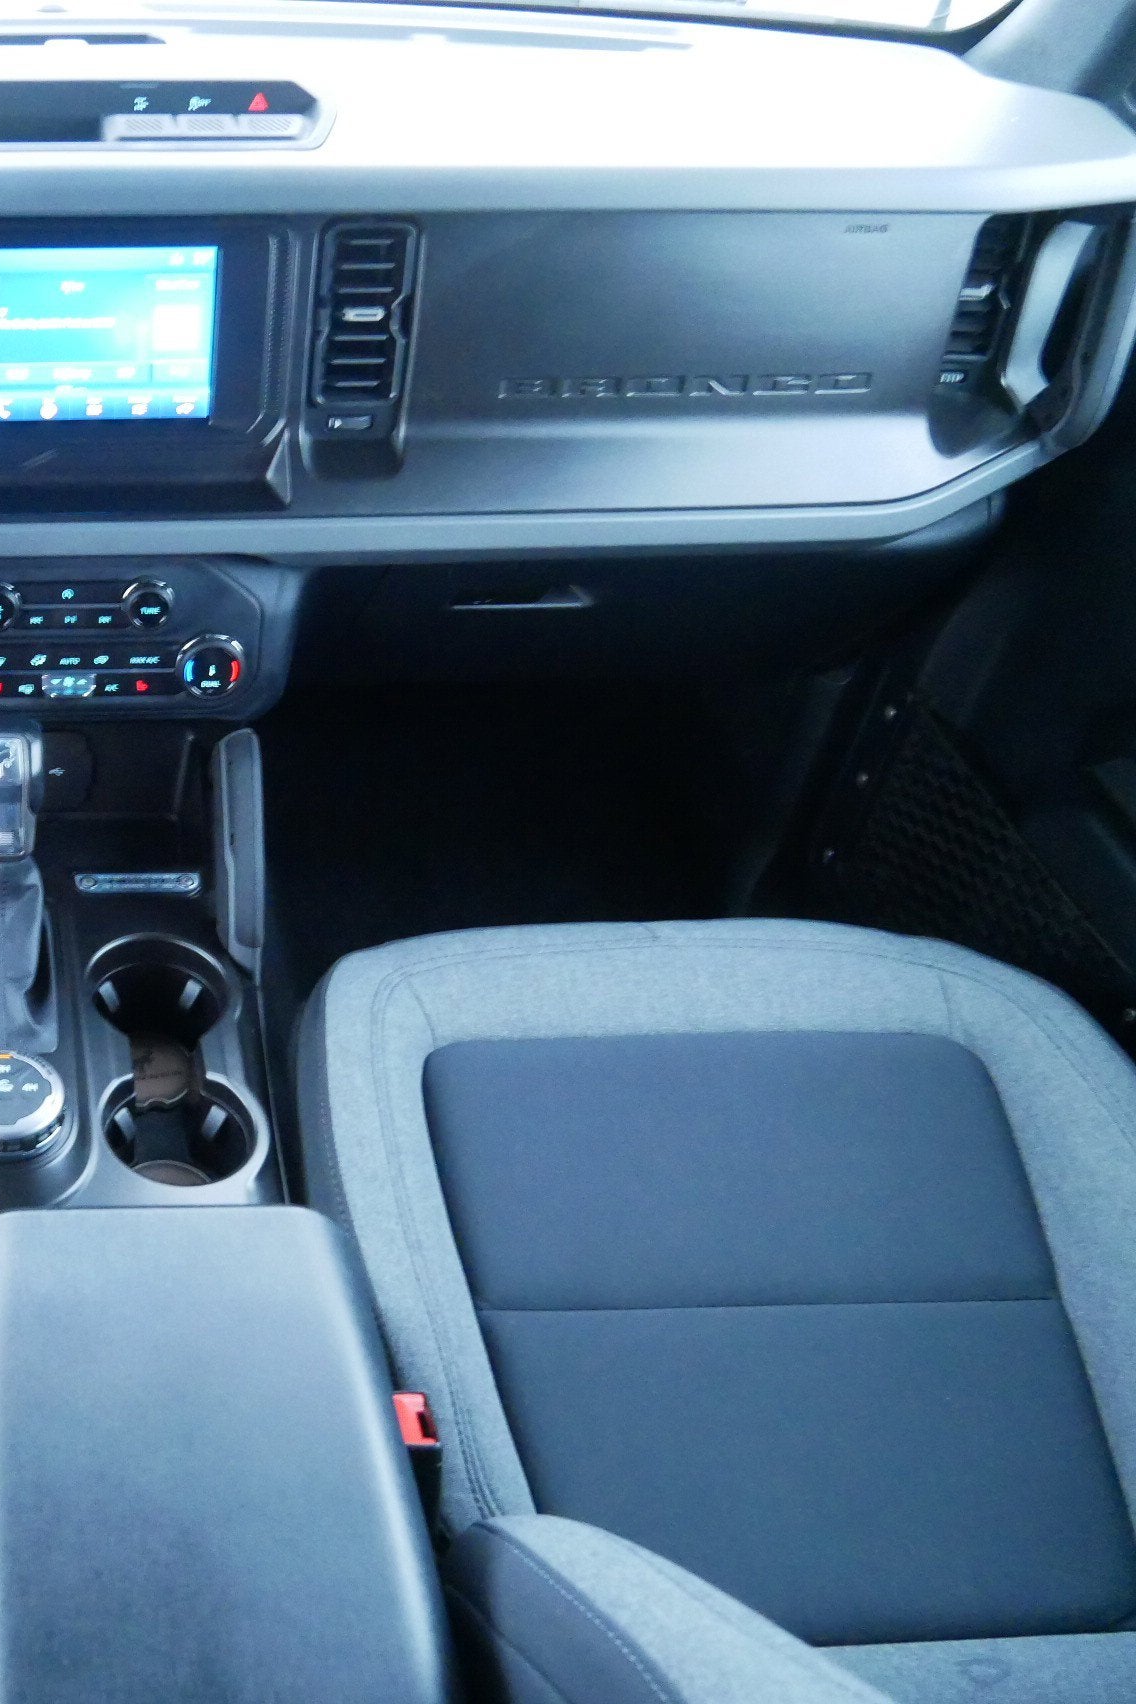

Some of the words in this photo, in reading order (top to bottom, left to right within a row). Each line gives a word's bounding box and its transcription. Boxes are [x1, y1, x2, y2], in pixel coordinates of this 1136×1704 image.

[844, 223, 890, 234] AIRBAG
[497, 371, 874, 400] BRONCO
[59, 657, 81, 665] AUTO
[21, 1082, 39, 1092] 4H
